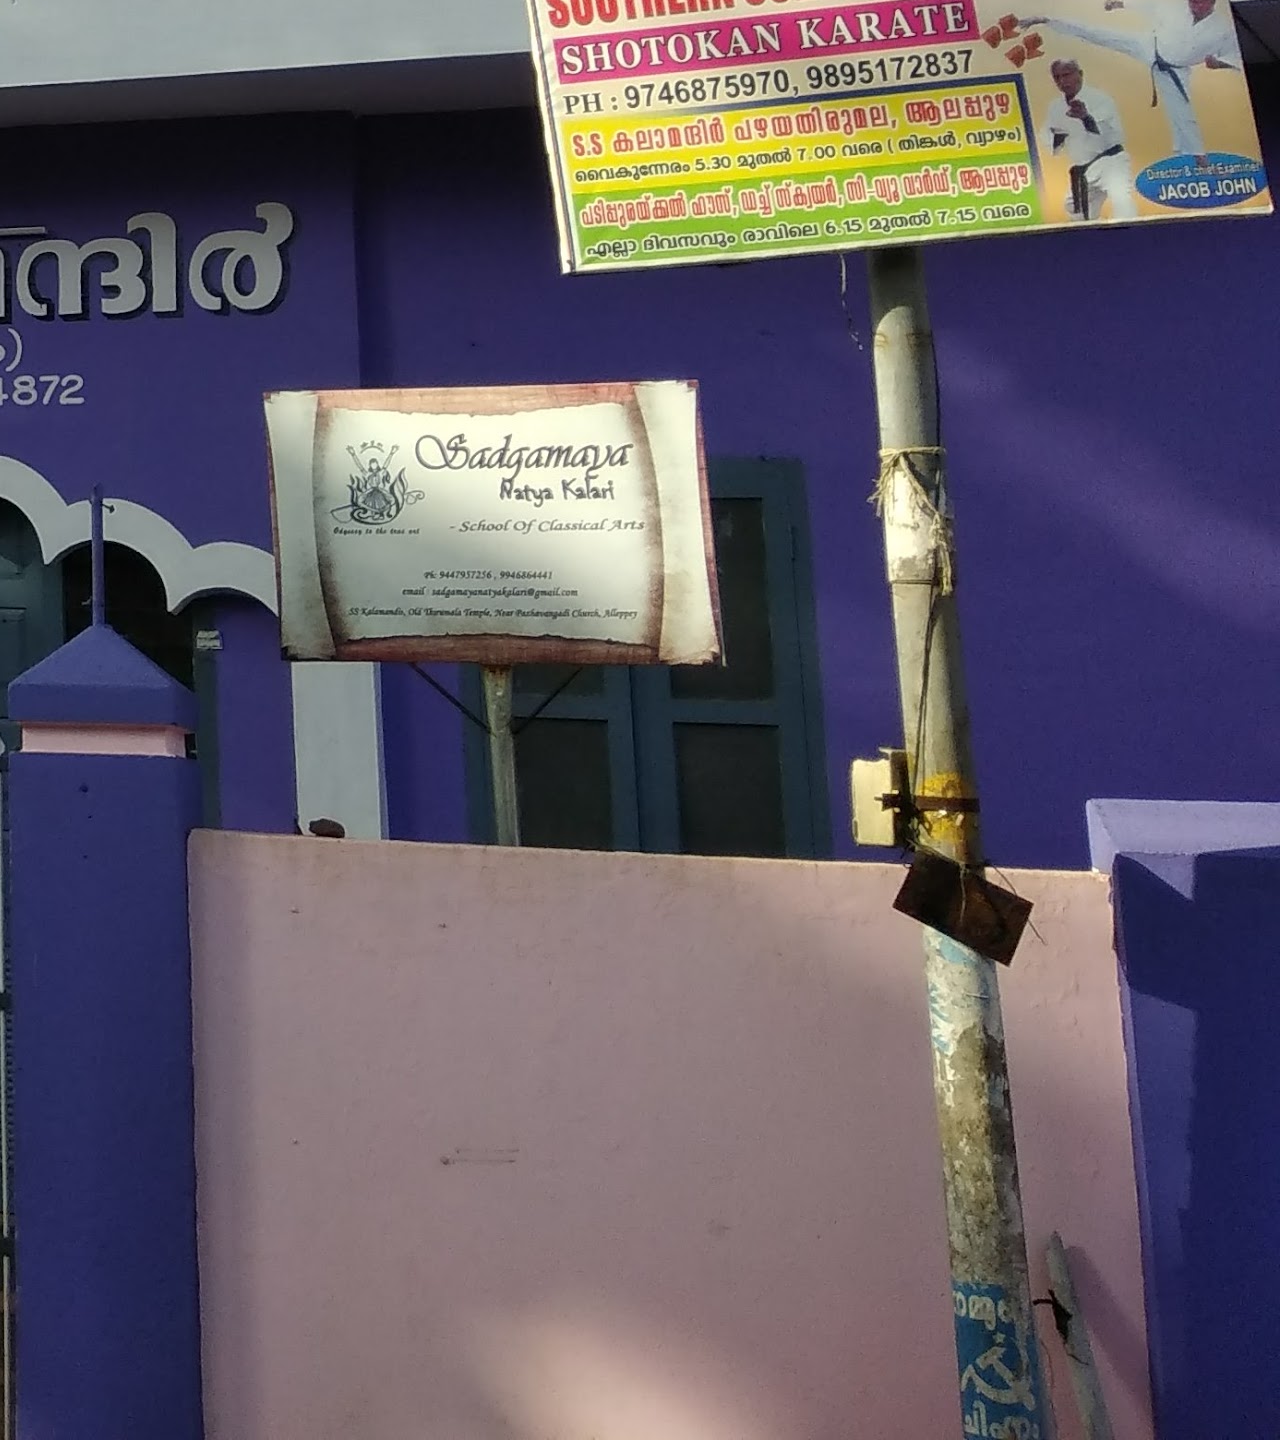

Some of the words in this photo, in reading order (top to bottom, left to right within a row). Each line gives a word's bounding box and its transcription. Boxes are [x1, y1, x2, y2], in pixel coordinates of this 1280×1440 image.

[562, 22, 782, 75] SHOTOKAN
[796, 0, 969, 50] KARATE
[563, 92, 604, 115] PH
[624, 69, 799, 109] 9746875970,
[807, 49, 974, 90] 9895172837
[572, 132, 603, 157] S.S
[904, 92, 1010, 126] ആലപ്പുഴ
[695, 156, 731, 171] 5.30
[798, 145, 836, 161] 7.00
[1158, 181, 1211, 201] JACOB
[1215, 177, 1257, 197] JOHN
[825, 220, 862, 235] 6.15
[937, 209, 976, 224] 7.15
[414, 433, 634, 481] Sadgamaya
[459, 520, 510, 533] School
[513, 520, 536, 535] Of
[538, 519, 609, 533] Classical
[607, 520, 646, 533] Arts
